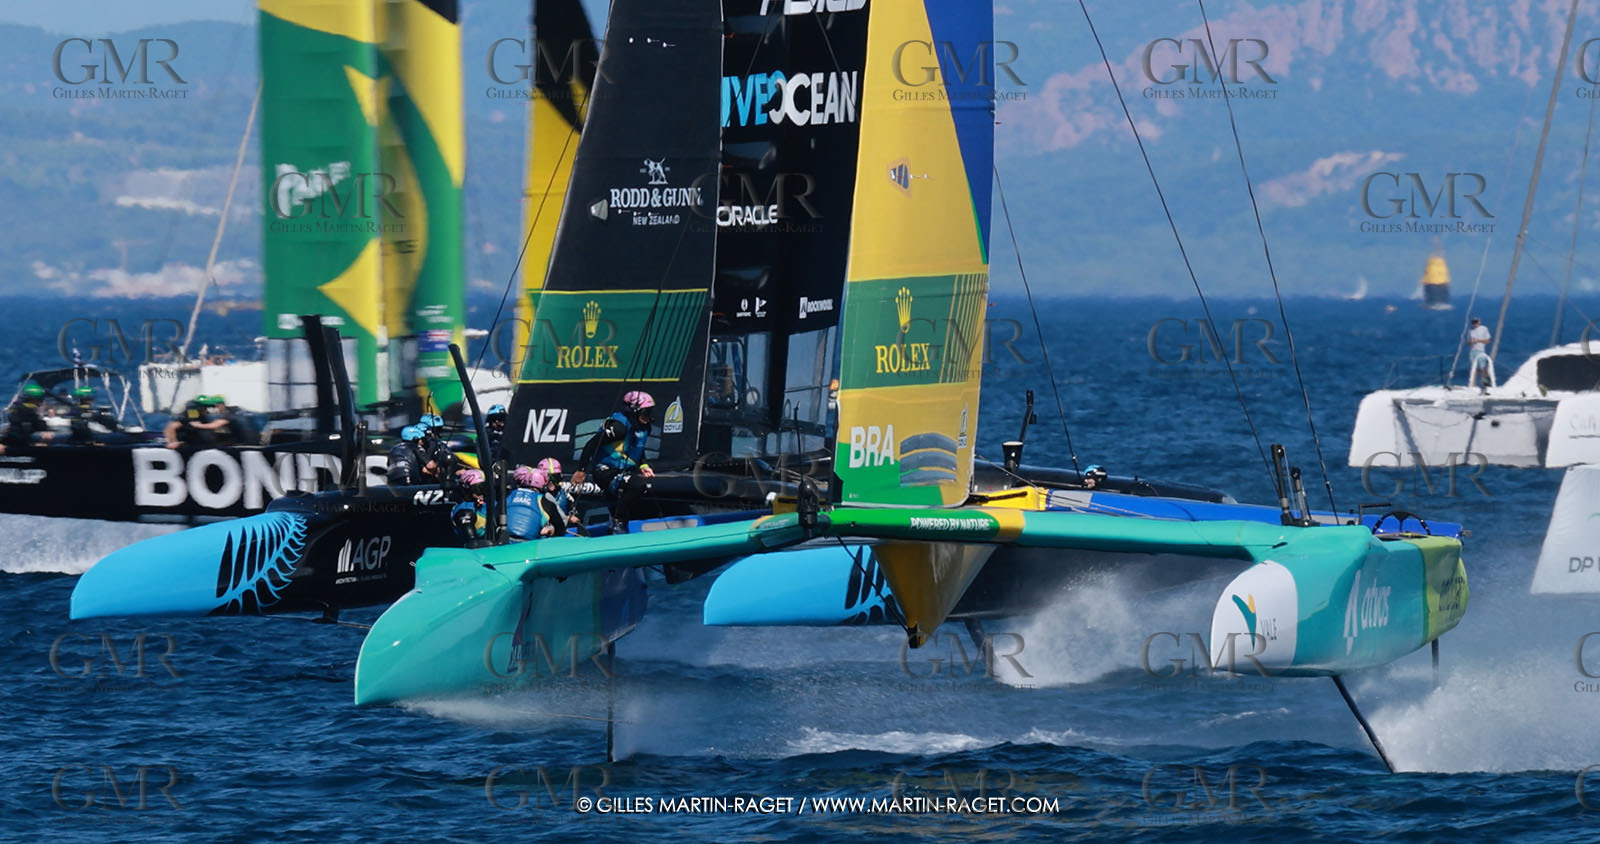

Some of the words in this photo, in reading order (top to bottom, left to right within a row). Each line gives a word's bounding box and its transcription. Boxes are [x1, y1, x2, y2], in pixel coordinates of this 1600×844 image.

[632, 215, 647, 226] NEW
[649, 214, 680, 226] ZEALAND
[716, 204, 778, 227] ORACLE
[556, 345, 619, 369] ROLEX
[875, 342, 931, 374] ROLEX
[523, 408, 571, 444] NZL
[849, 423, 895, 469] BRA
[910, 517, 949, 531] POWERED
[949, 517, 959, 531] BY
[960, 517, 990, 531] NATURE
[352, 536, 392, 570] AGP
[1568, 556, 1594, 574] DP
